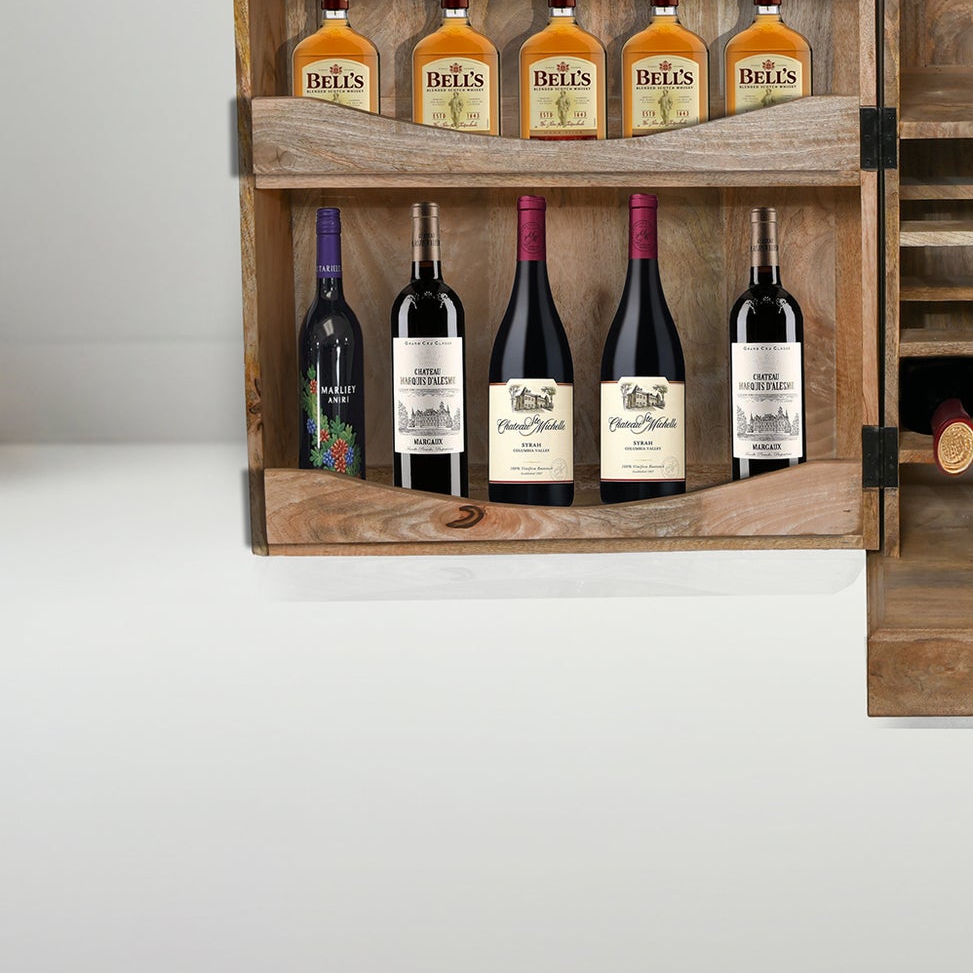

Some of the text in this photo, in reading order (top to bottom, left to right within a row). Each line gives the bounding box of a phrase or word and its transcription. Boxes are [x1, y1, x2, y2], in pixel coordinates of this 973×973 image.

[306, 72, 364, 88] BELL'S
[426, 71, 484, 87] BELL'S
[533, 70, 591, 86] BELL'S
[635, 69, 693, 85] BELL'S
[739, 68, 797, 84] BELL'S
[497, 418, 532, 434] Chateau
[609, 416, 644, 432] Chateau
